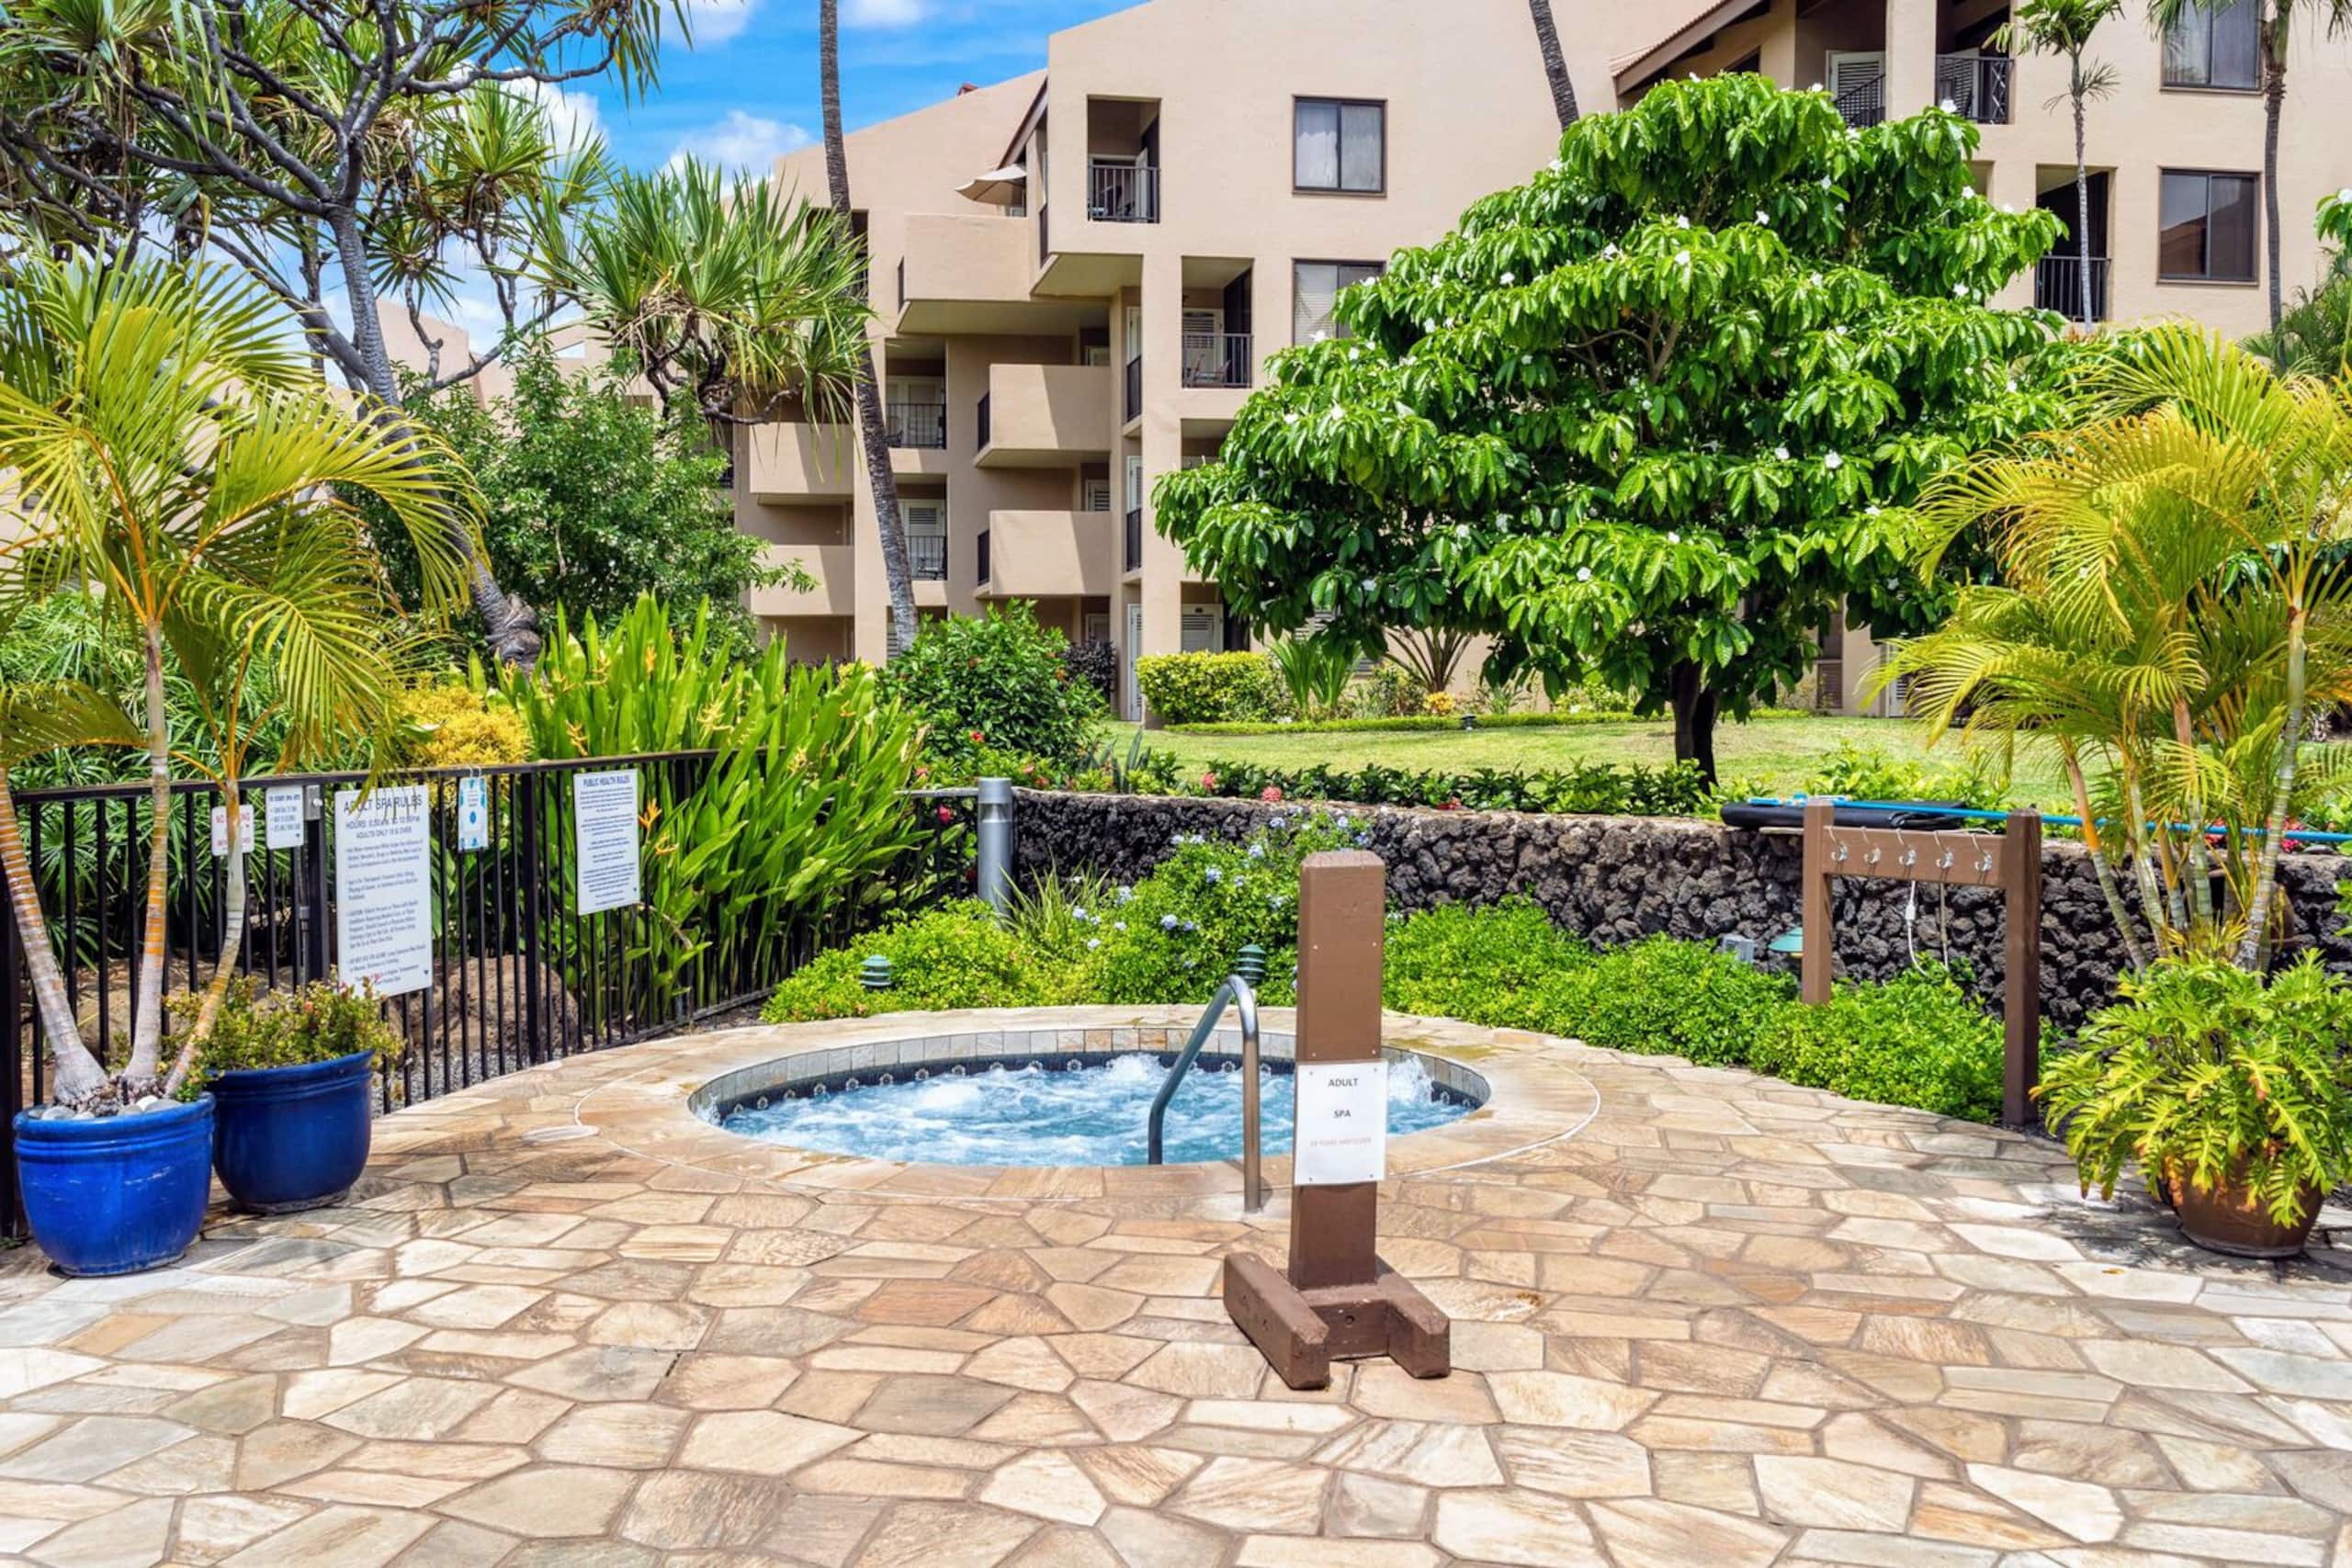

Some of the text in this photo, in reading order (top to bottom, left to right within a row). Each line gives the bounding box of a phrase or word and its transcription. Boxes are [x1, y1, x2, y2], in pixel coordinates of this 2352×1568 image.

[376, 796, 393, 810] SPA
[1329, 1077, 1359, 1088] ADULT
[1333, 1109, 1351, 1119] SPA
